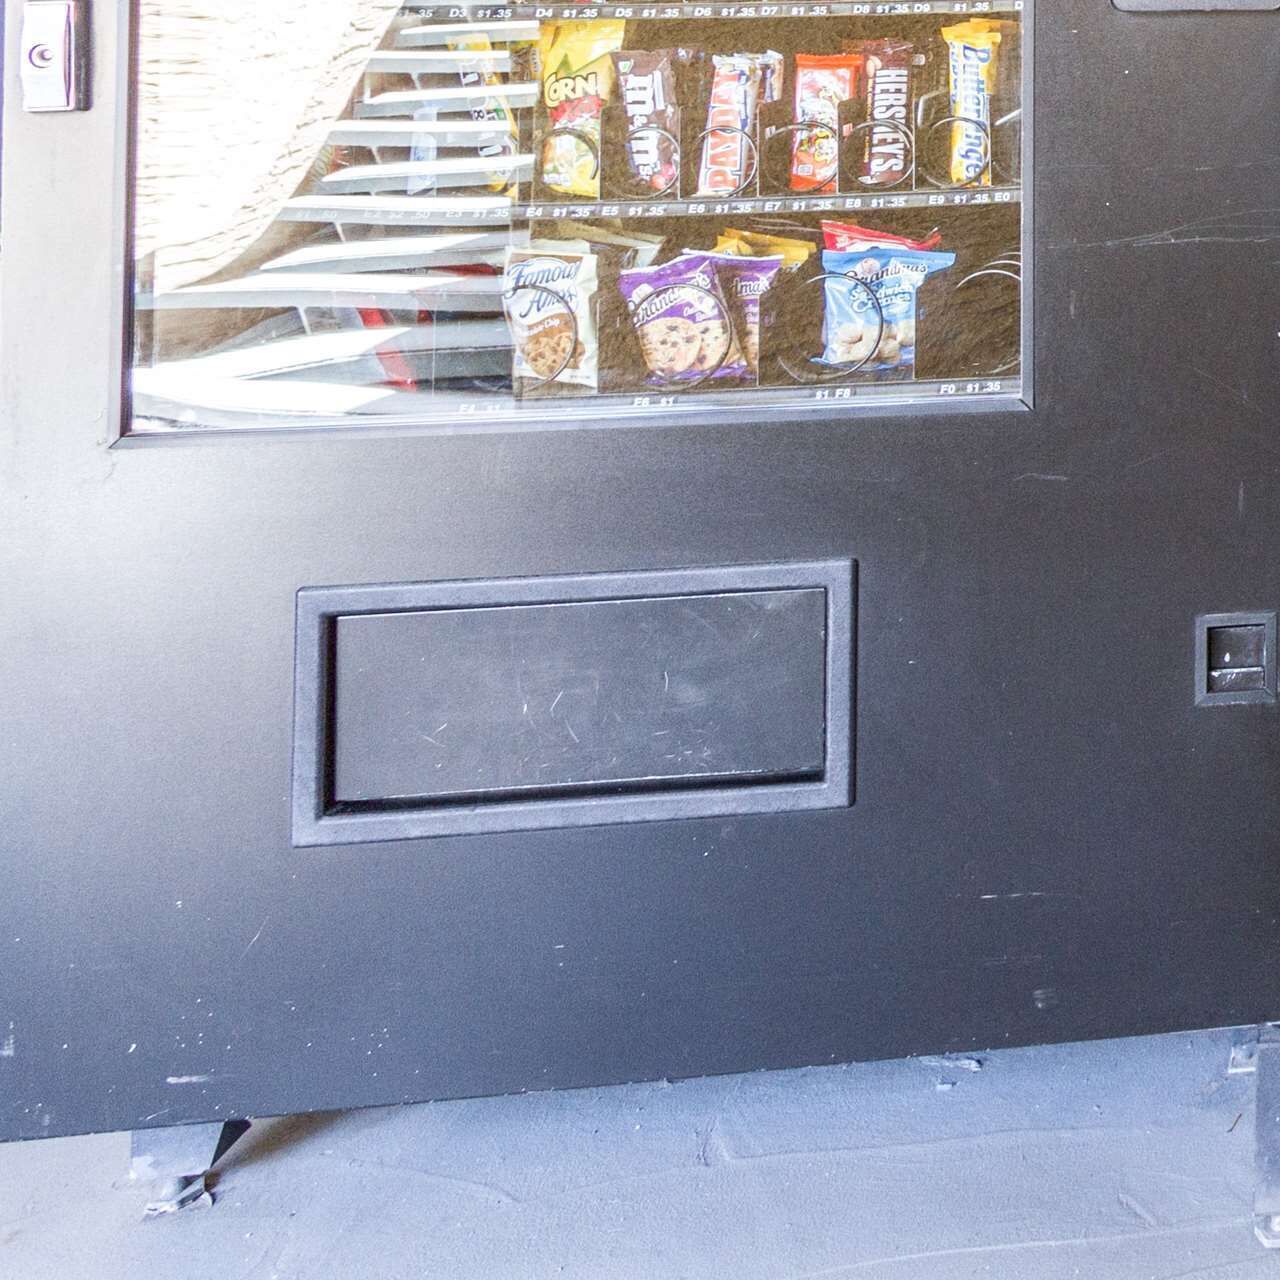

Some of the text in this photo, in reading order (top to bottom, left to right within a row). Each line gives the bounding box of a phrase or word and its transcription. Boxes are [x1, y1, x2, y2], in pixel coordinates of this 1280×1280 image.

[535, 8, 553, 18] D4
[615, 8, 633, 18] D5
[694, 7, 712, 17] D6
[761, 6, 779, 16] D7
[913, 3, 931, 13] D9
[526, 207, 543, 217] E4
[602, 206, 619, 215] E5
[688, 204, 705, 214] E6
[764, 202, 781, 211] E7
[845, 198, 861, 208] E8
[928, 195, 945, 205] E9
[994, 192, 1011, 202] E0
[504, 260, 582, 300] Famous
[940, 384, 956, 394] F0
